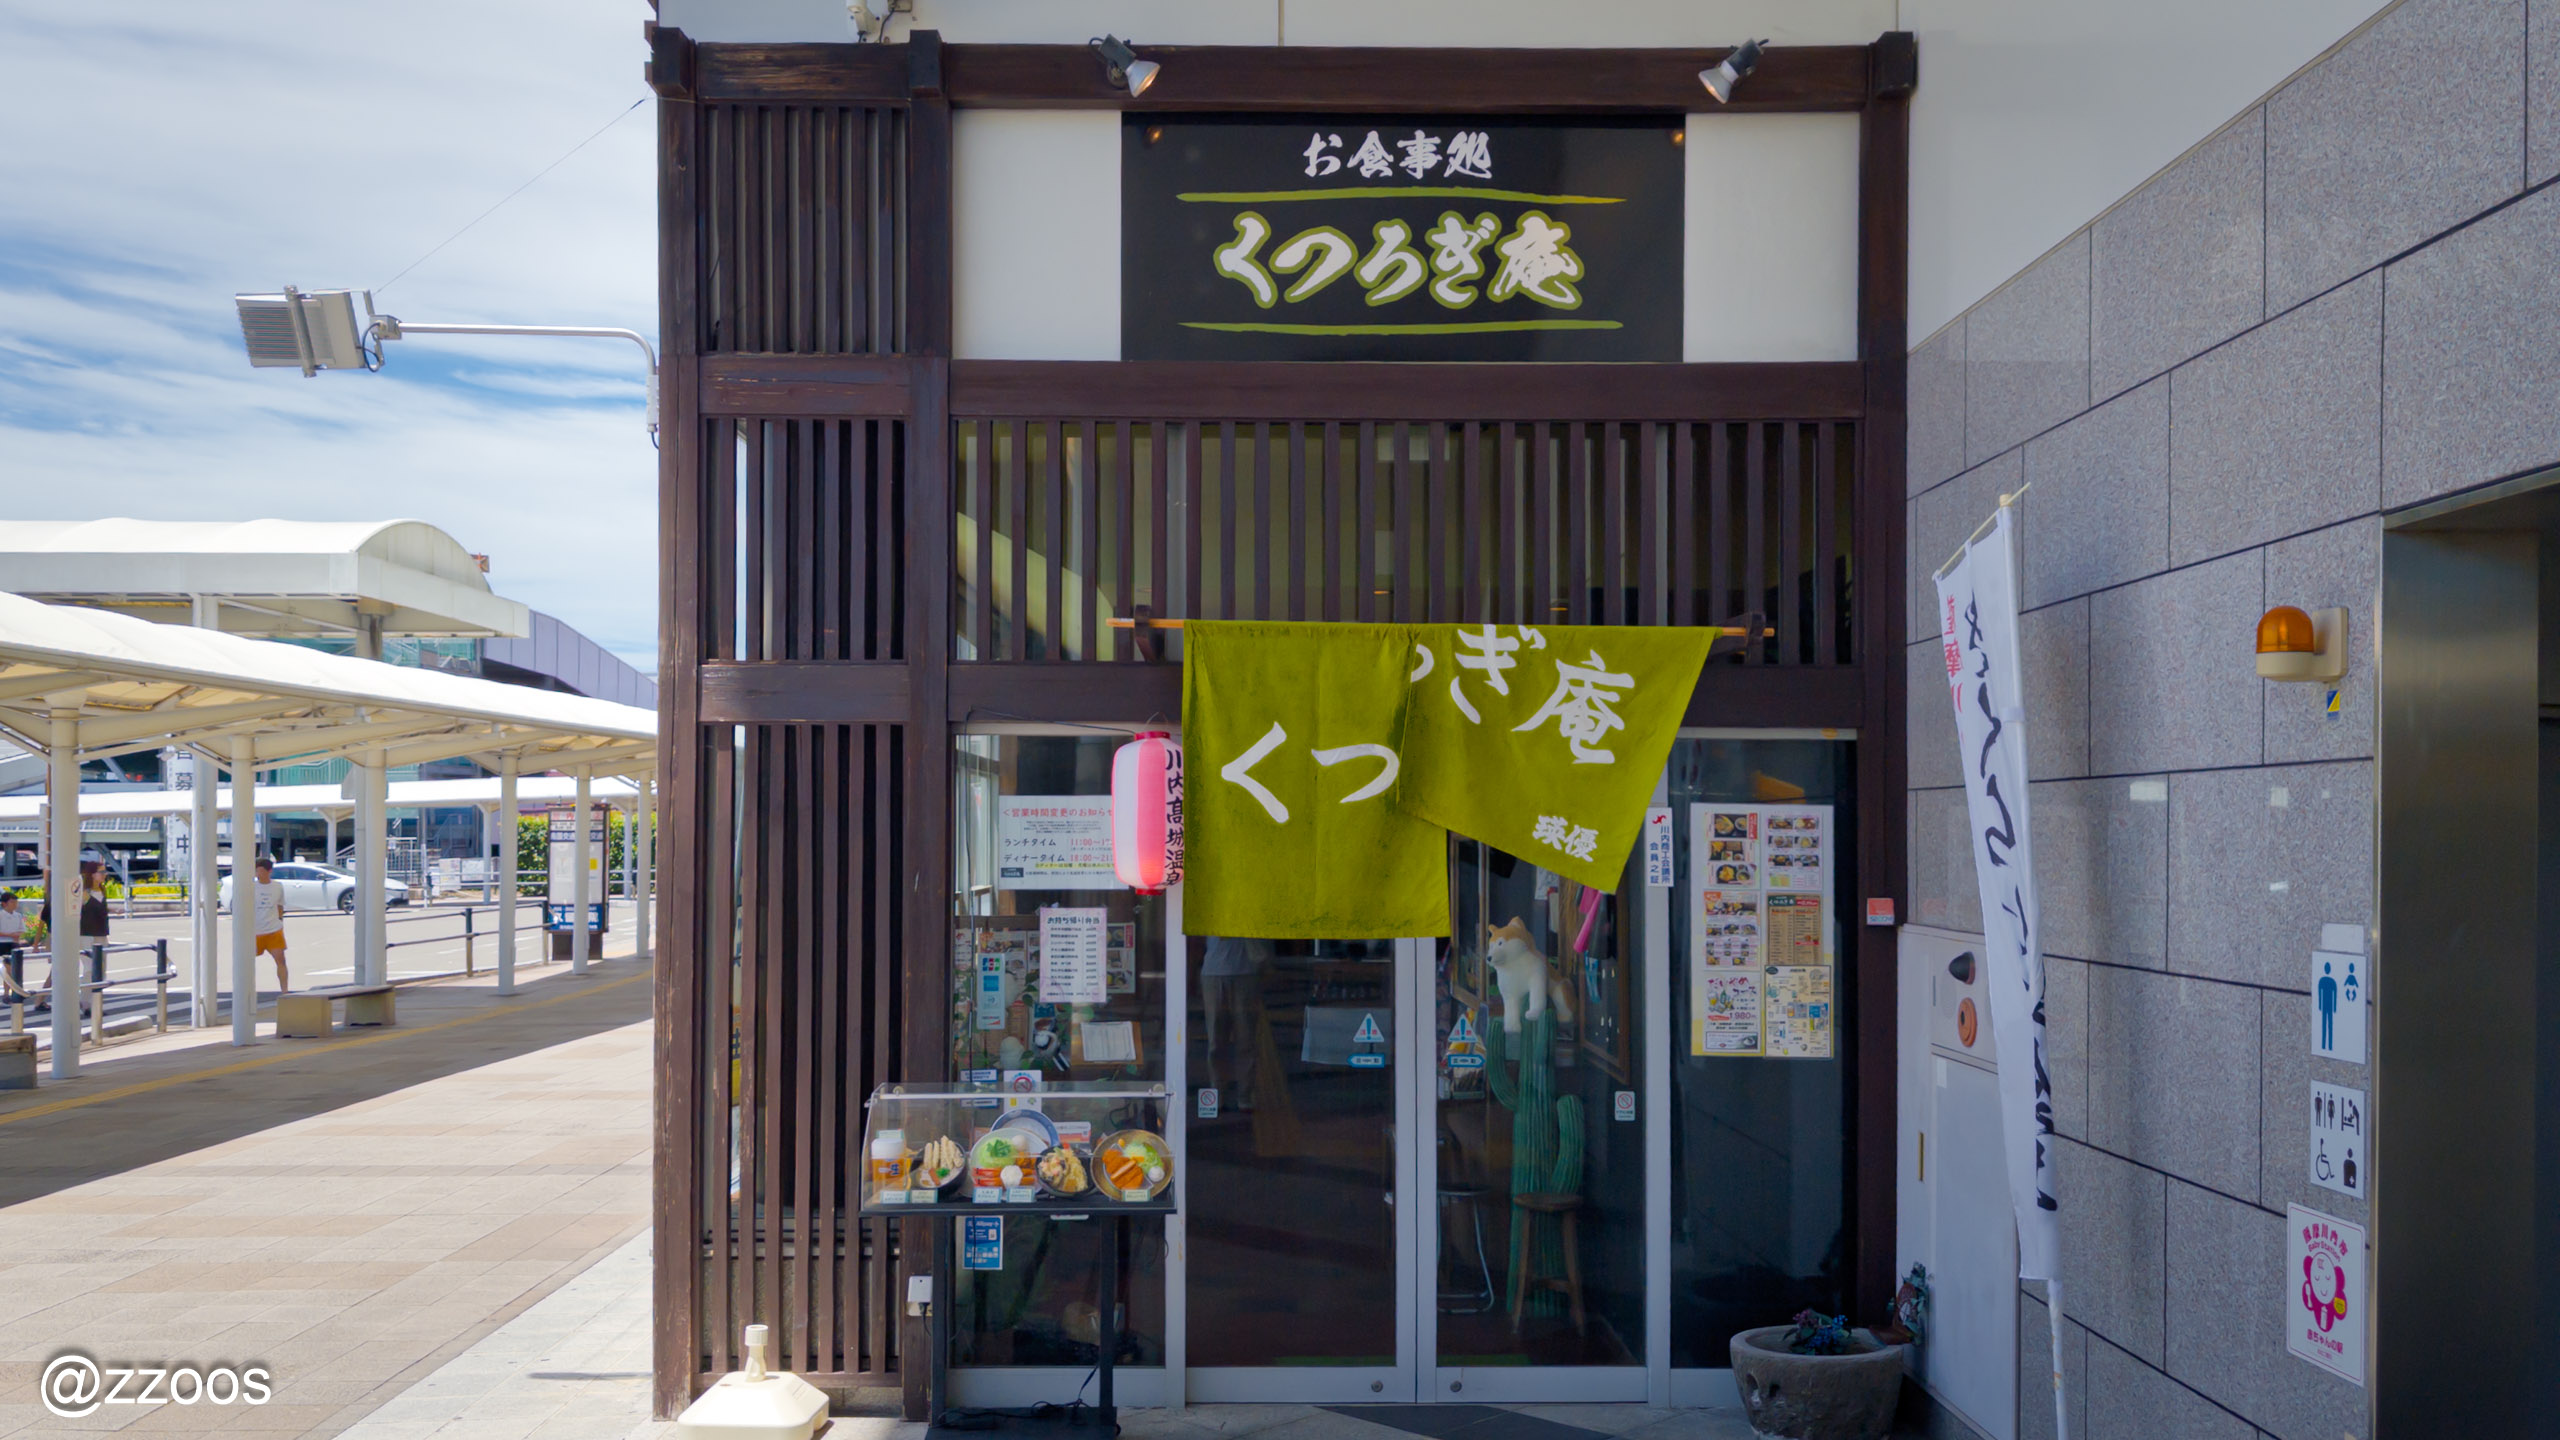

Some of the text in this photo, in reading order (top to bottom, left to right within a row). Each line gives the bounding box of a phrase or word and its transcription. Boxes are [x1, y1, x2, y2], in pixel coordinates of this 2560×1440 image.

[1303, 130, 1493, 180] お食事処
[1213, 210, 1584, 311] くつろぎ庵
[1003, 838, 1057, 847] ランチタイム
[1003, 853, 1065, 863] ディナータイム
[1047, 916, 1100, 925] お持ち帰り弁当
[2308, 1241, 2341, 1263] Baby Station
